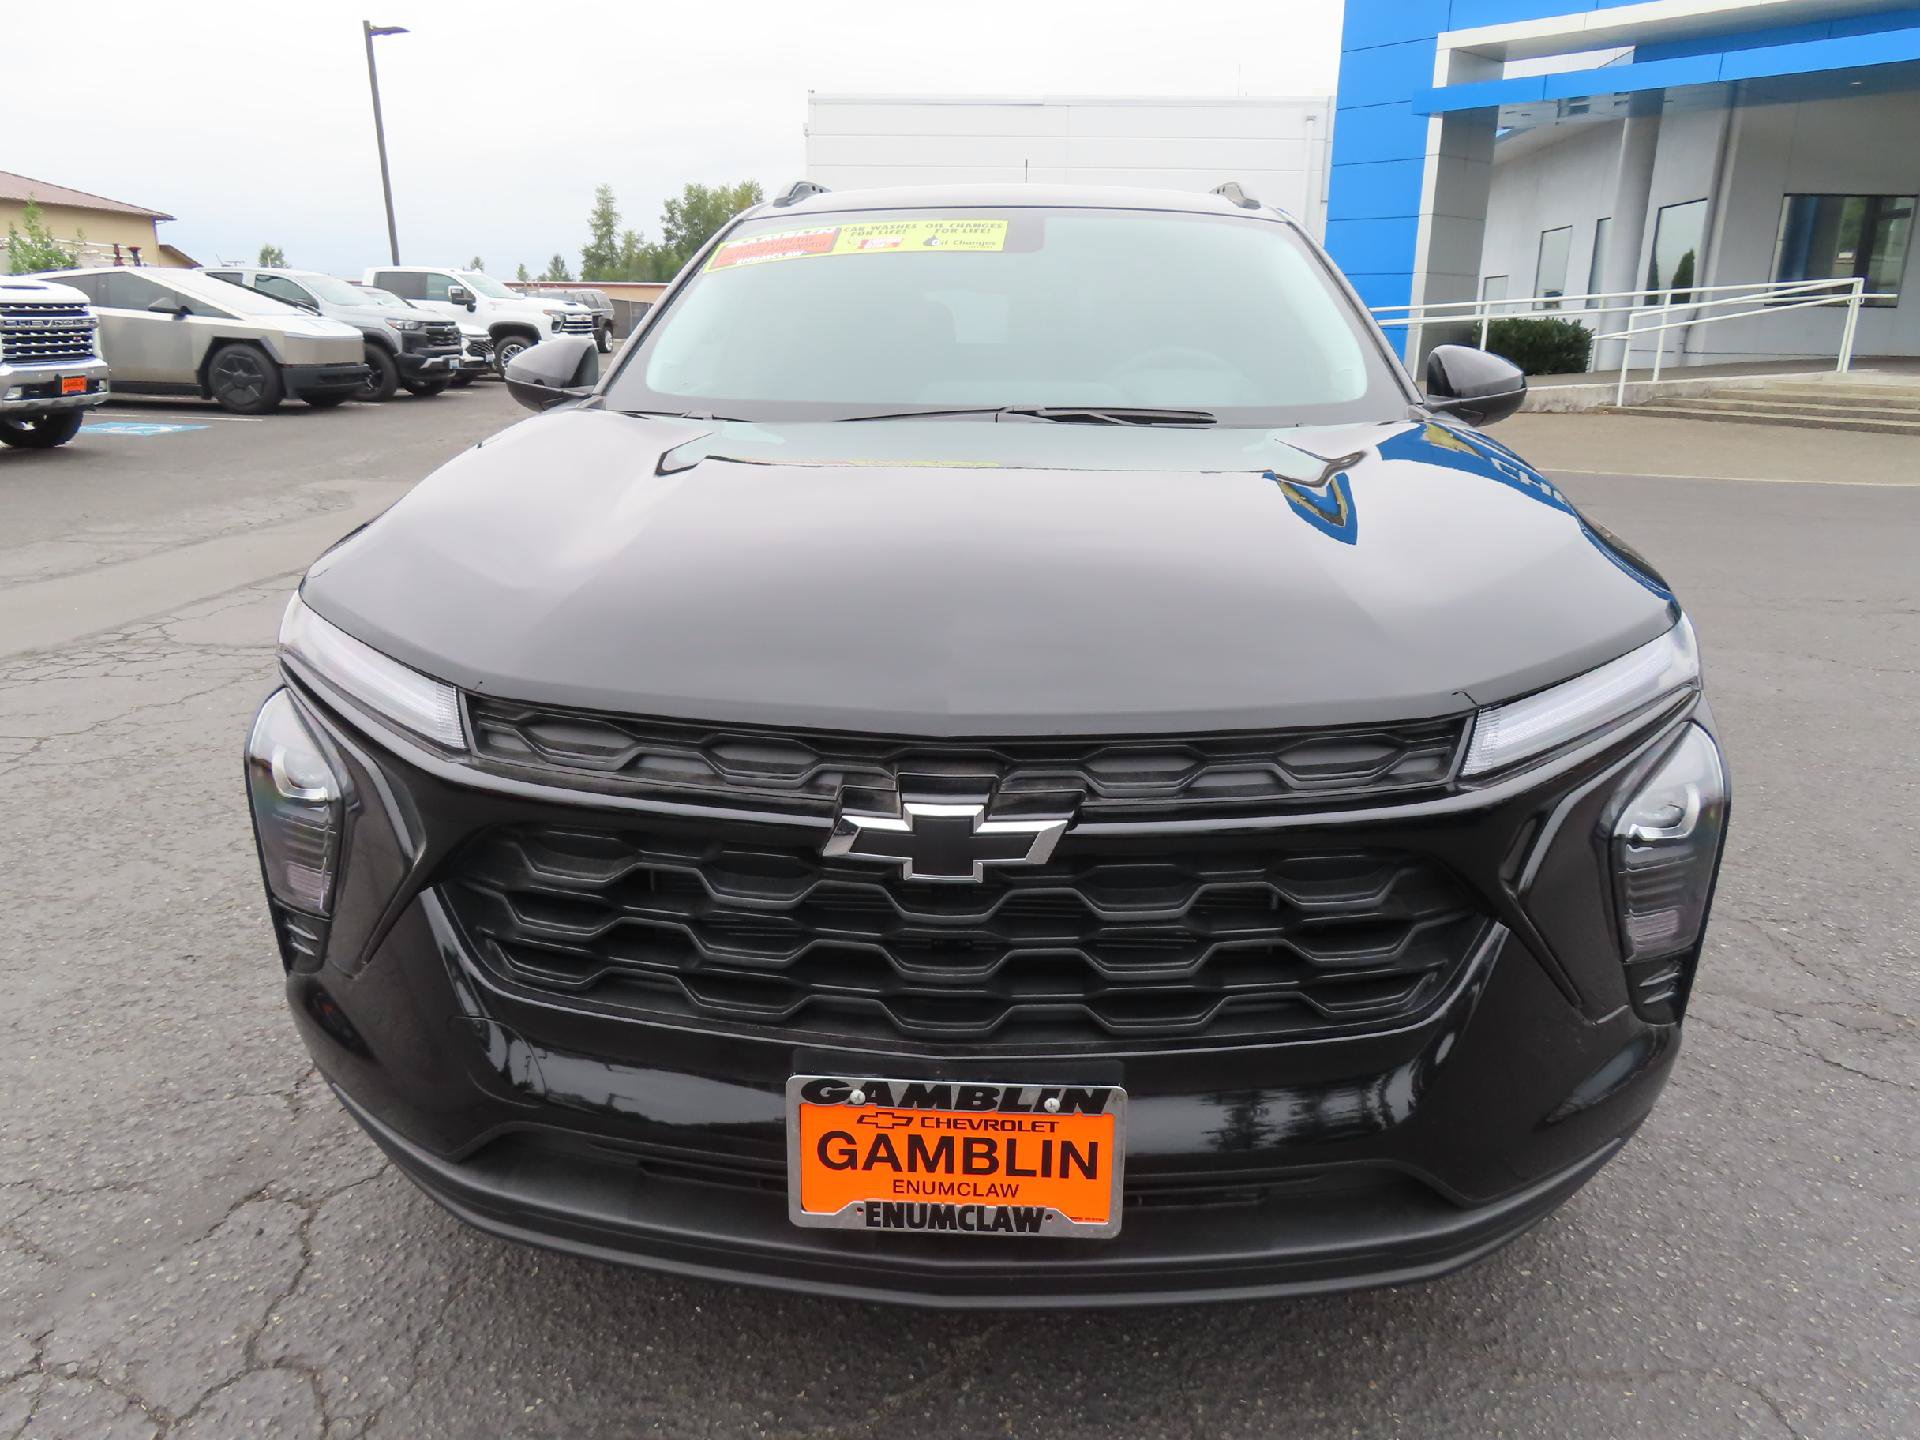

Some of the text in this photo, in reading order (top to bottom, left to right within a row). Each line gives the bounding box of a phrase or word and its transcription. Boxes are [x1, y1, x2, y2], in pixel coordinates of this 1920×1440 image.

[800, 1077, 1113, 1116] GAMBLIN
[920, 1116, 1060, 1133] CHEVROLET
[816, 1130, 1099, 1180] GAMBLIN
[893, 1179, 1020, 1198] ENUMCLAW
[865, 1200, 1046, 1234] ENUMCLAW
